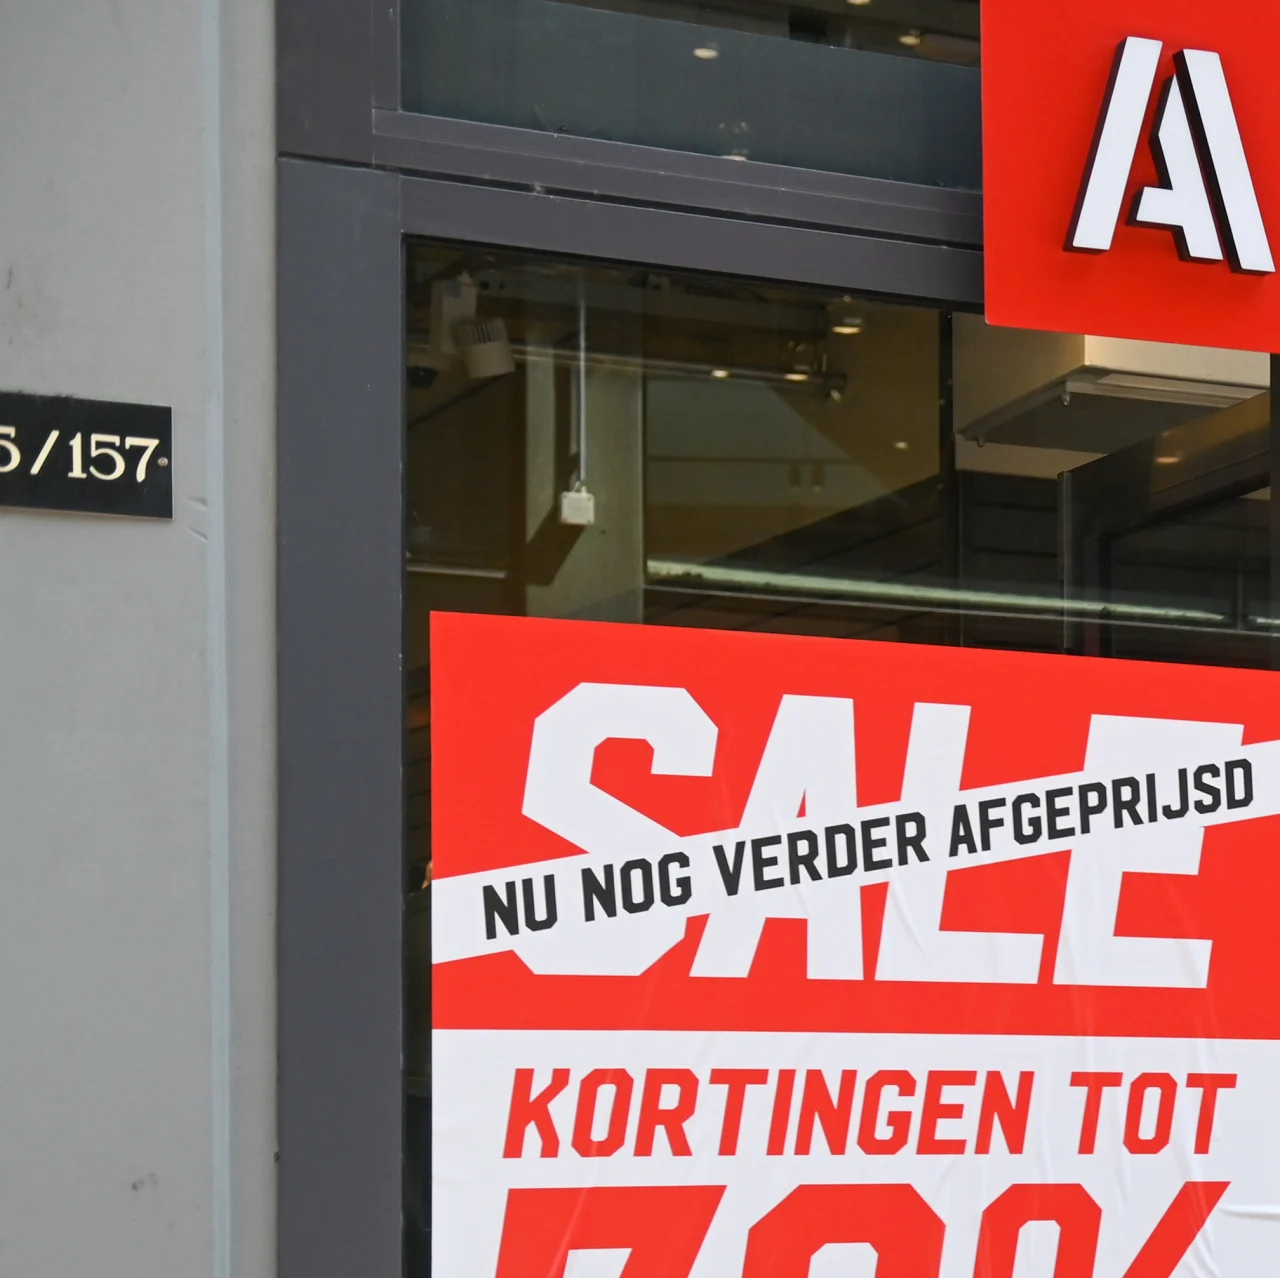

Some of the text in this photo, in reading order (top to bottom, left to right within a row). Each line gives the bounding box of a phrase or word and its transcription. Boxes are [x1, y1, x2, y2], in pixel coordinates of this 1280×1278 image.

[482, 757, 1254, 940] NU NOG VERDER AFGEPRIJSD
[522, 681, 1245, 989] SALE
[502, 1067, 1238, 1159] KORTINGEN TOT
